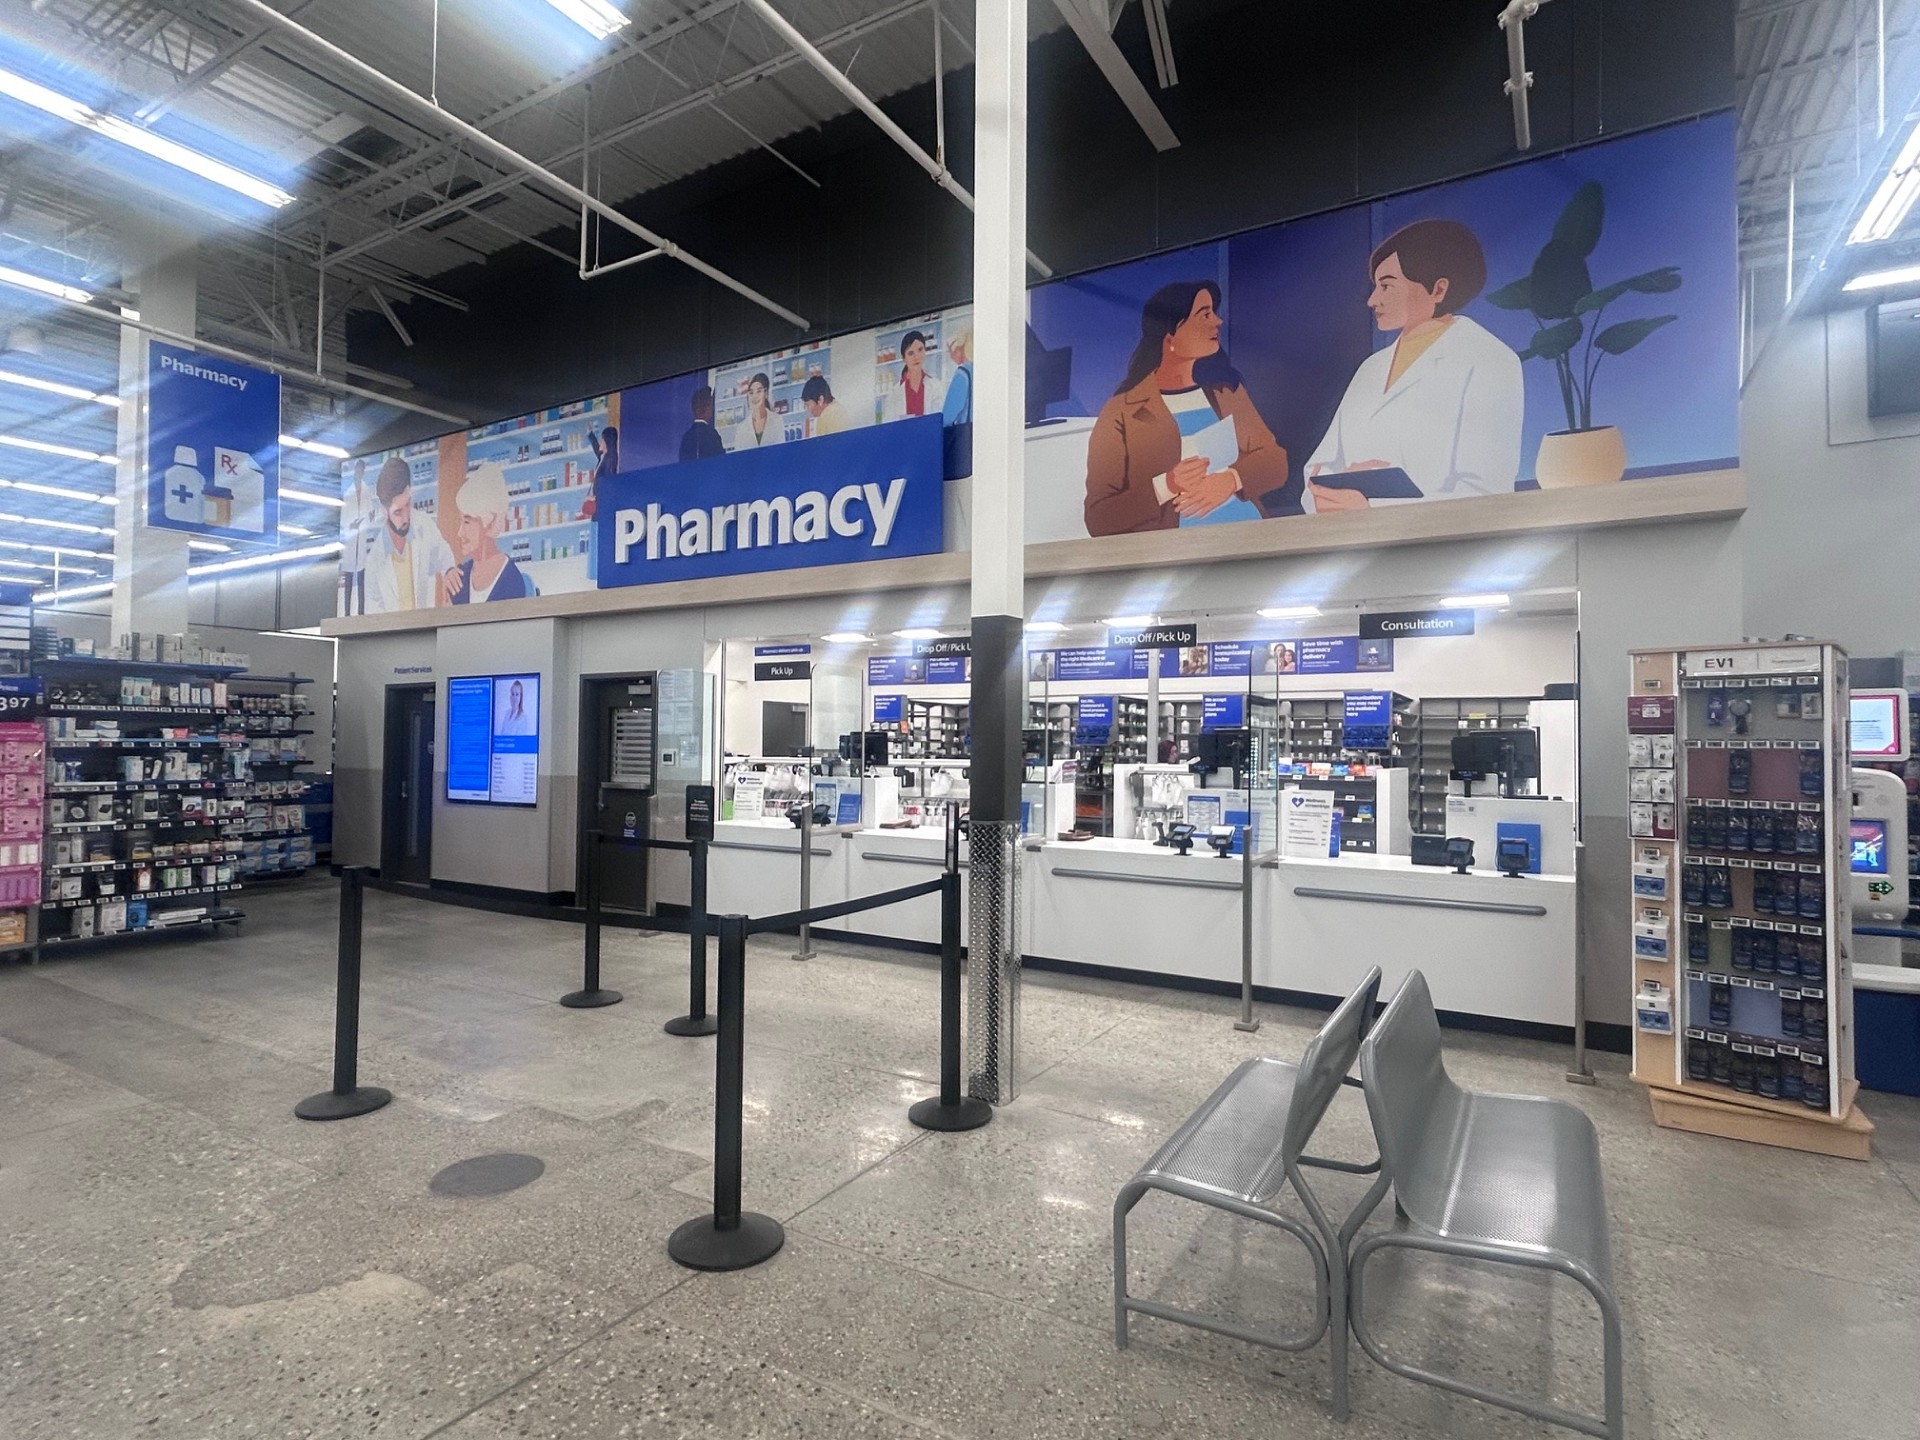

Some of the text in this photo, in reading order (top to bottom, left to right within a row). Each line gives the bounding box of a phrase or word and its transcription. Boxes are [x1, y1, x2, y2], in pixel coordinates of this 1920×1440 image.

[160, 355, 248, 391] Pharmacy
[614, 477, 907, 564] Pharmacy
[1381, 618, 1454, 631] Consultation
[1114, 634, 1136, 646] Drop
[1177, 631, 1191, 643] Up
[917, 644, 934, 654] Drop
[1704, 657, 1734, 669] EV1
[771, 667, 794, 676] Pick Up
